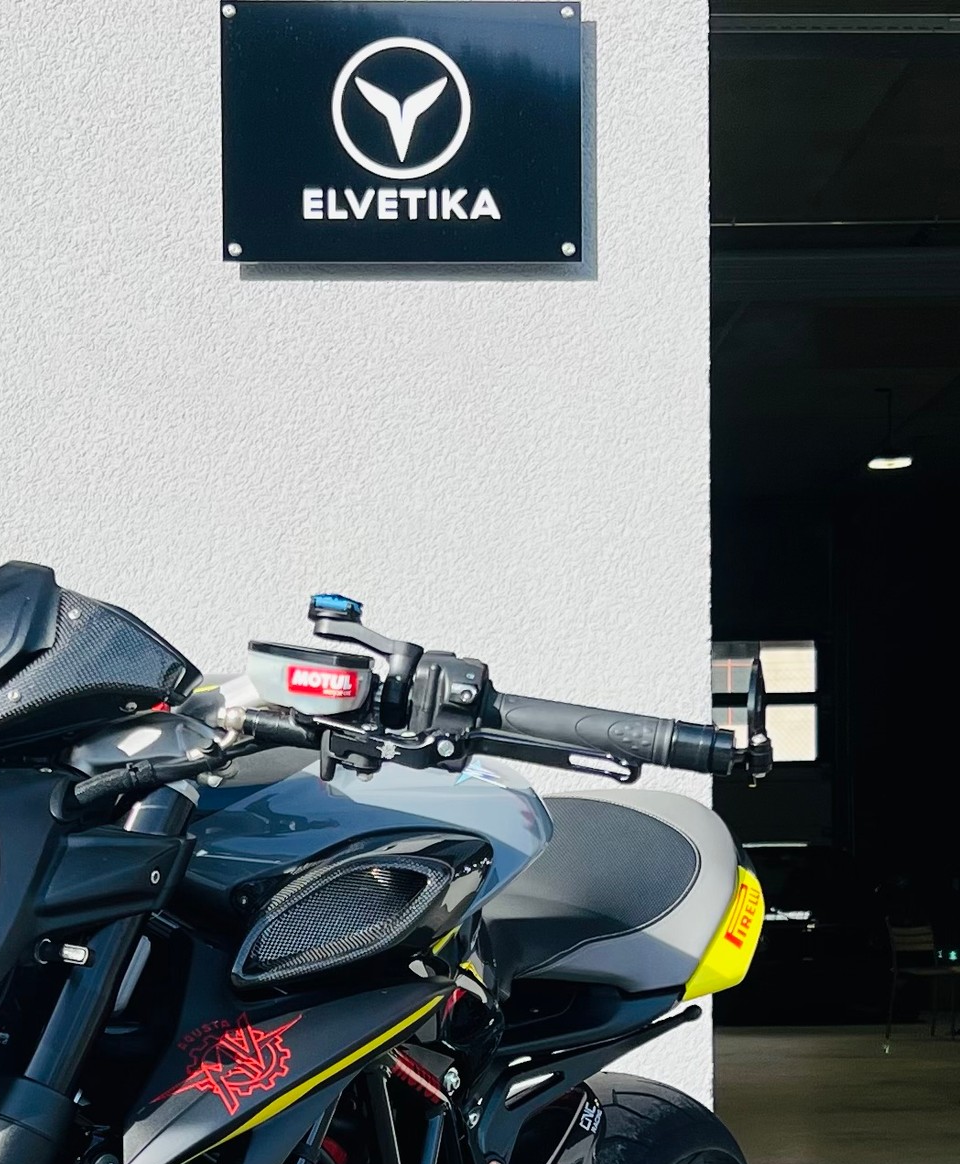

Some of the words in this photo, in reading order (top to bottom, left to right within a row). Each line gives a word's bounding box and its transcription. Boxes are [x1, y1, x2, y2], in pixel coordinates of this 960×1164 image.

[302, 187, 501, 220] ELVETIKA
[291, 669, 352, 690] MOTUL
[724, 883, 760, 949] PIRELLI
